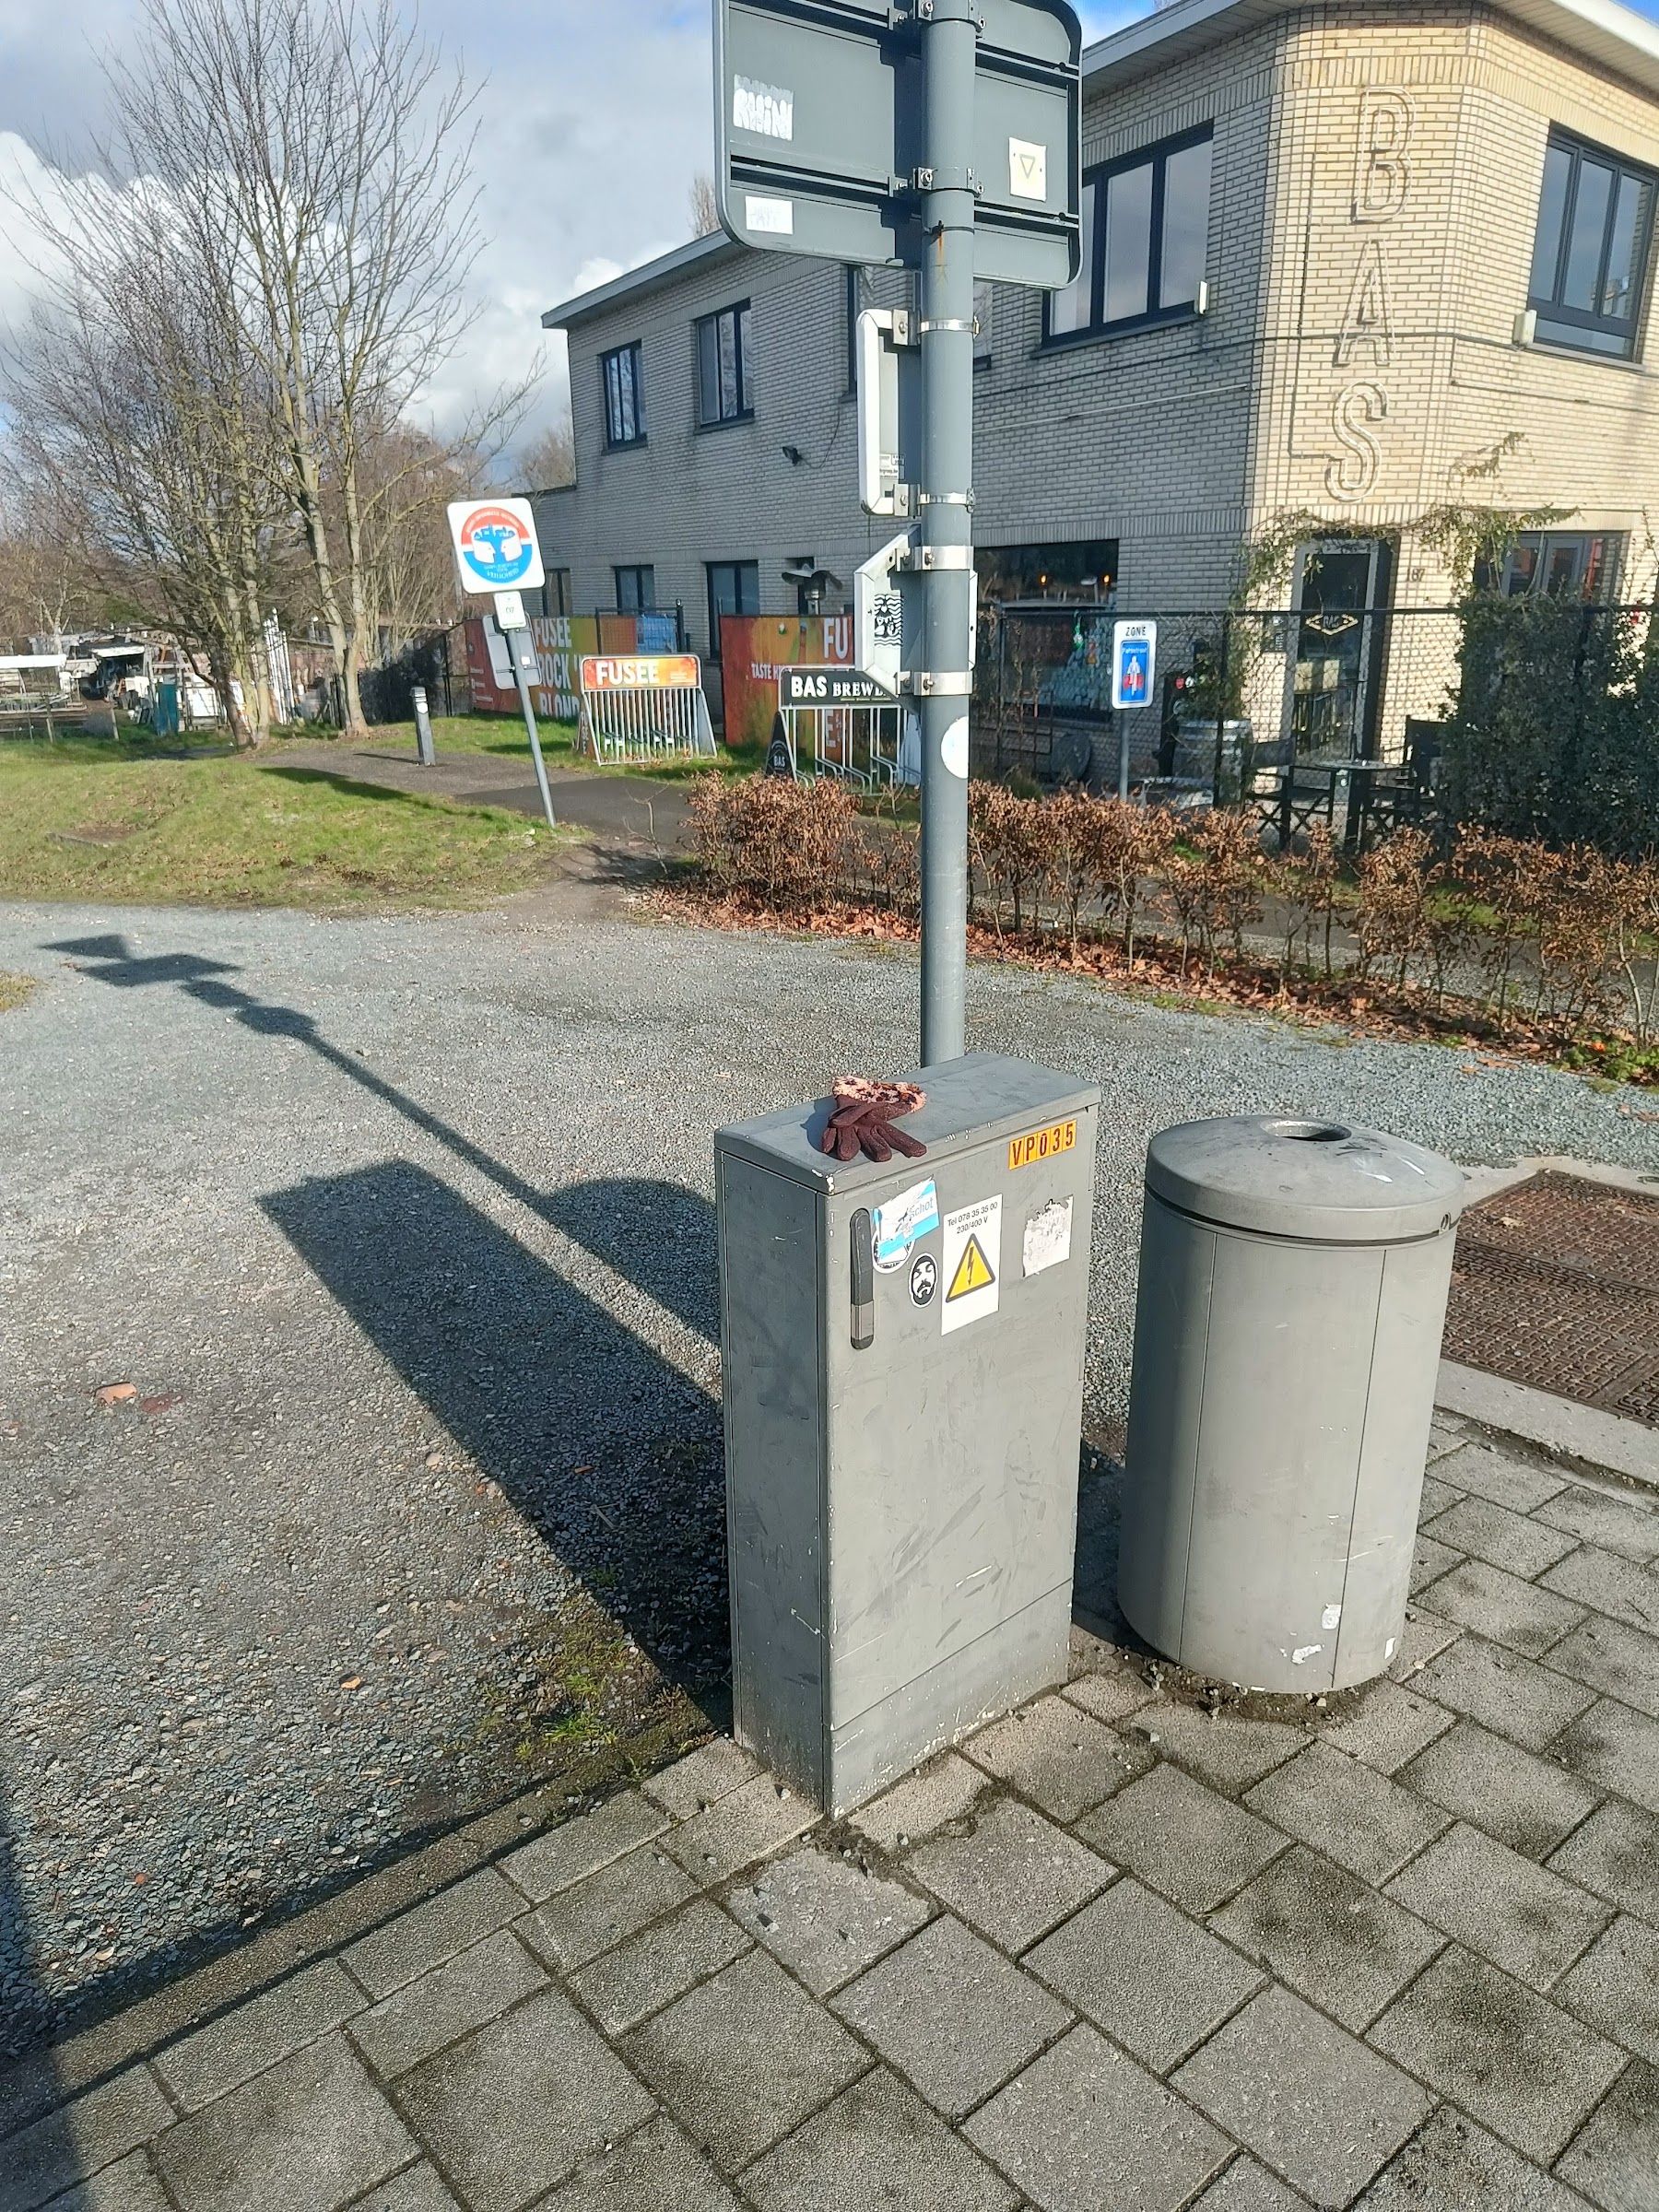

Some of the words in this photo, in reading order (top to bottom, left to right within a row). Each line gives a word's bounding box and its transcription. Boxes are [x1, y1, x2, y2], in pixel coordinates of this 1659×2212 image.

[1324, 86, 1416, 503] BAS
[532, 617, 571, 648] FUSEE
[1125, 627, 1146, 636] ZONE
[596, 661, 659, 686] FUSEE
[751, 663, 772, 680] TASTE
[791, 676, 828, 698] BAS
[774, 756, 786, 768] BAS
[1013, 1124, 1074, 1165] VP035
[947, 1218, 958, 1227] Tel
[958, 1212, 971, 1223] 078
[971, 1208, 980, 1218] 35
[981, 1205, 989, 1214] 35
[989, 1201, 998, 1210] 00
[957, 1218, 982, 1234] 230/400
[983, 1215, 989, 1224] V
